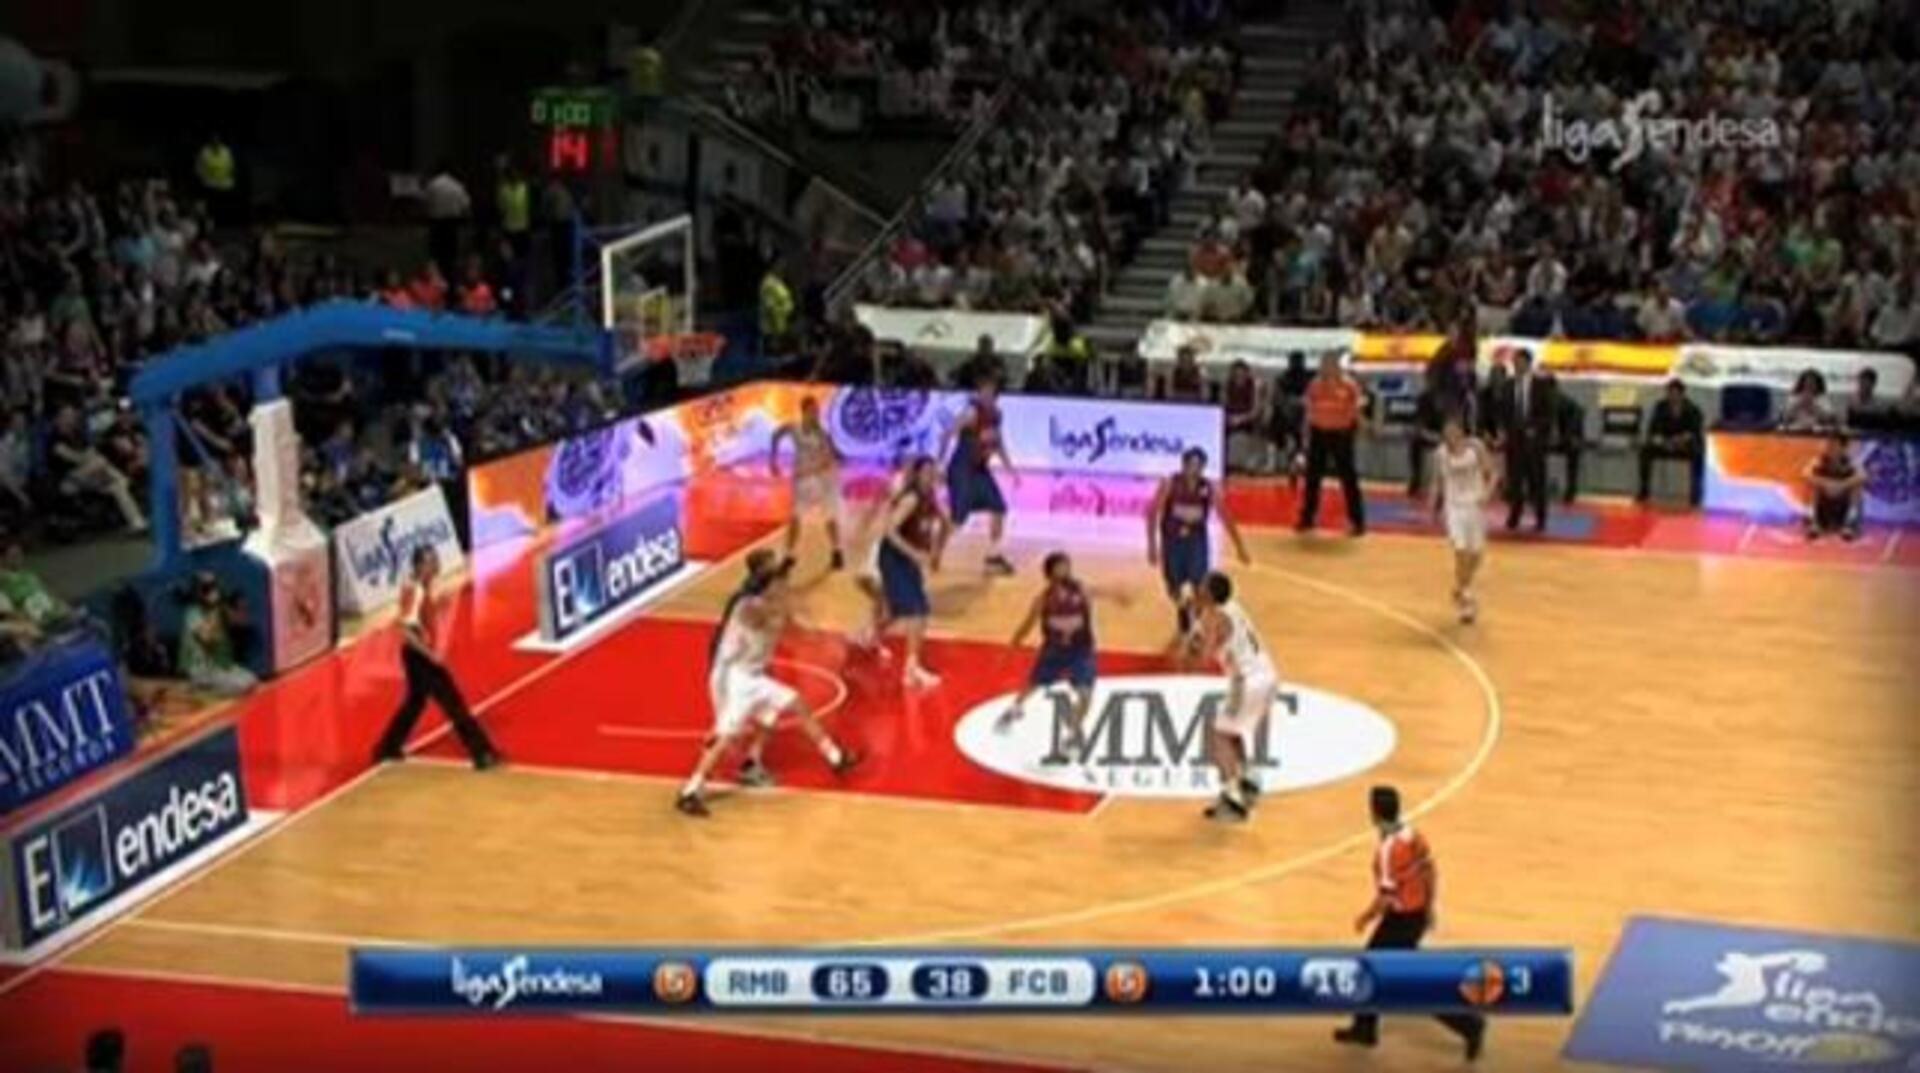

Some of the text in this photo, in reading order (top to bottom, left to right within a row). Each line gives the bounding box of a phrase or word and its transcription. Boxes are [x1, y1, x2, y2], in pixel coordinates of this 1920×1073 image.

[607, 527, 680, 598] endesa
[1040, 688, 1299, 768] MMT
[116, 771, 238, 877] endesa
